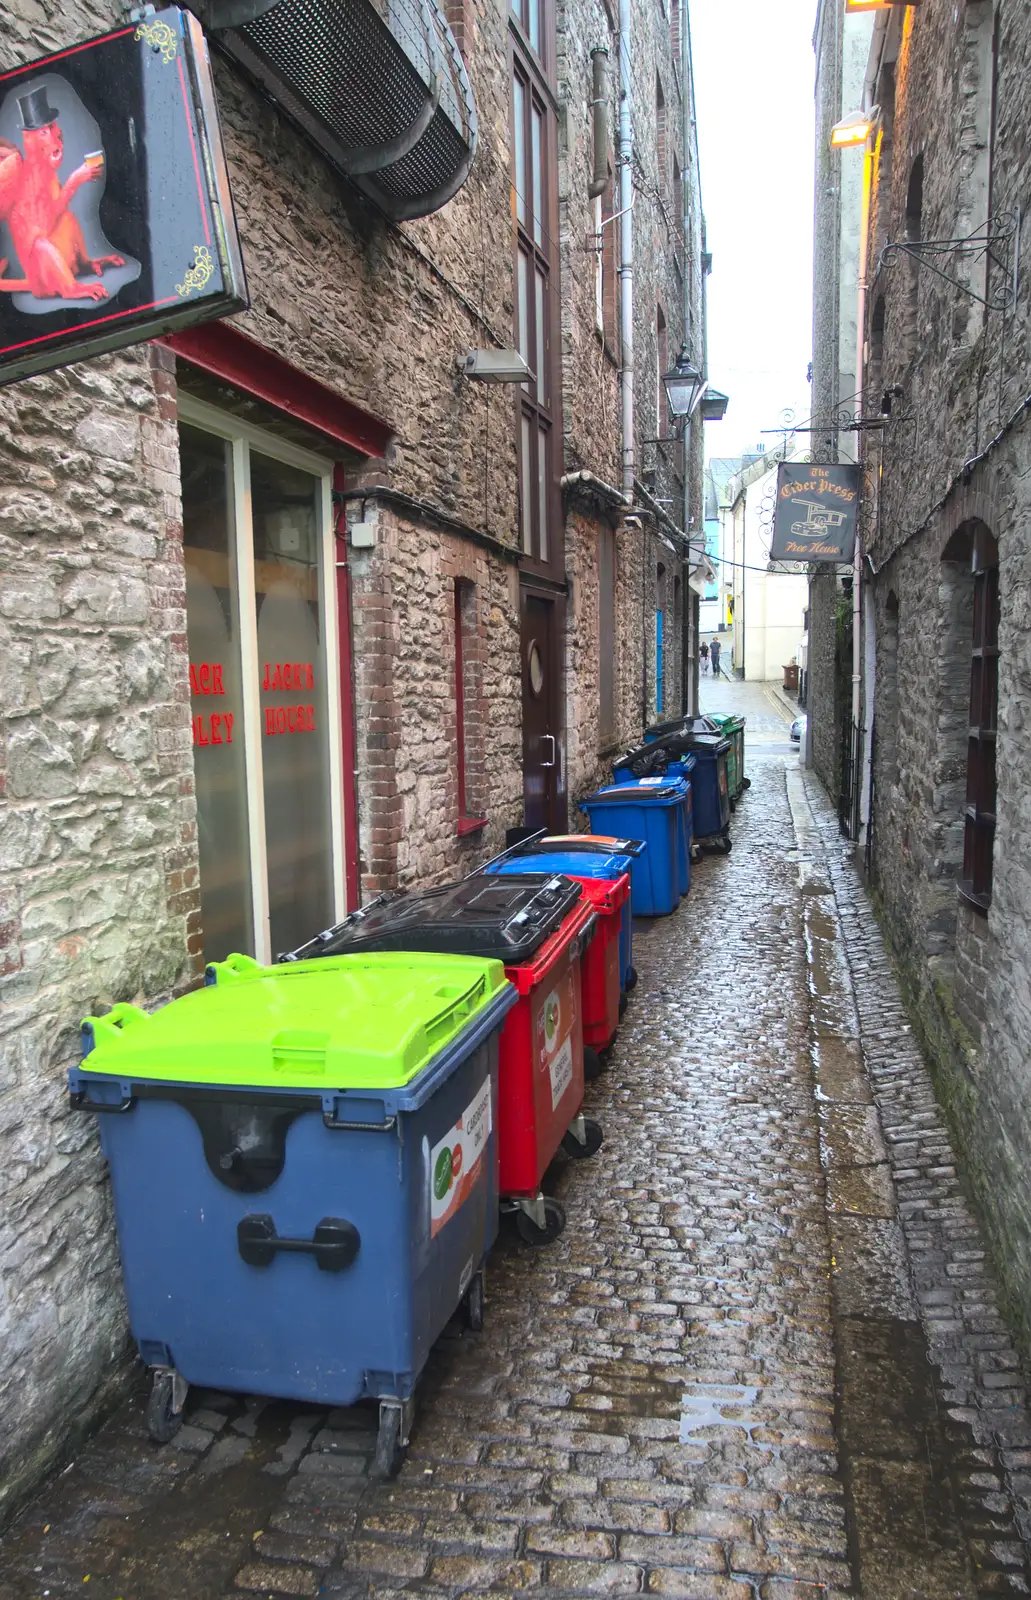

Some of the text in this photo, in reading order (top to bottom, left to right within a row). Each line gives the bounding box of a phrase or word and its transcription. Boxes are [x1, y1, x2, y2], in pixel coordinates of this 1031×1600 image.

[810, 467, 830, 477] The
[781, 480, 817, 498] Cider
[785, 541, 840, 553] Free House
[189, 663, 226, 696] ACK
[192, 712, 234, 747] LEY
[264, 704, 316, 735] HOUSE
